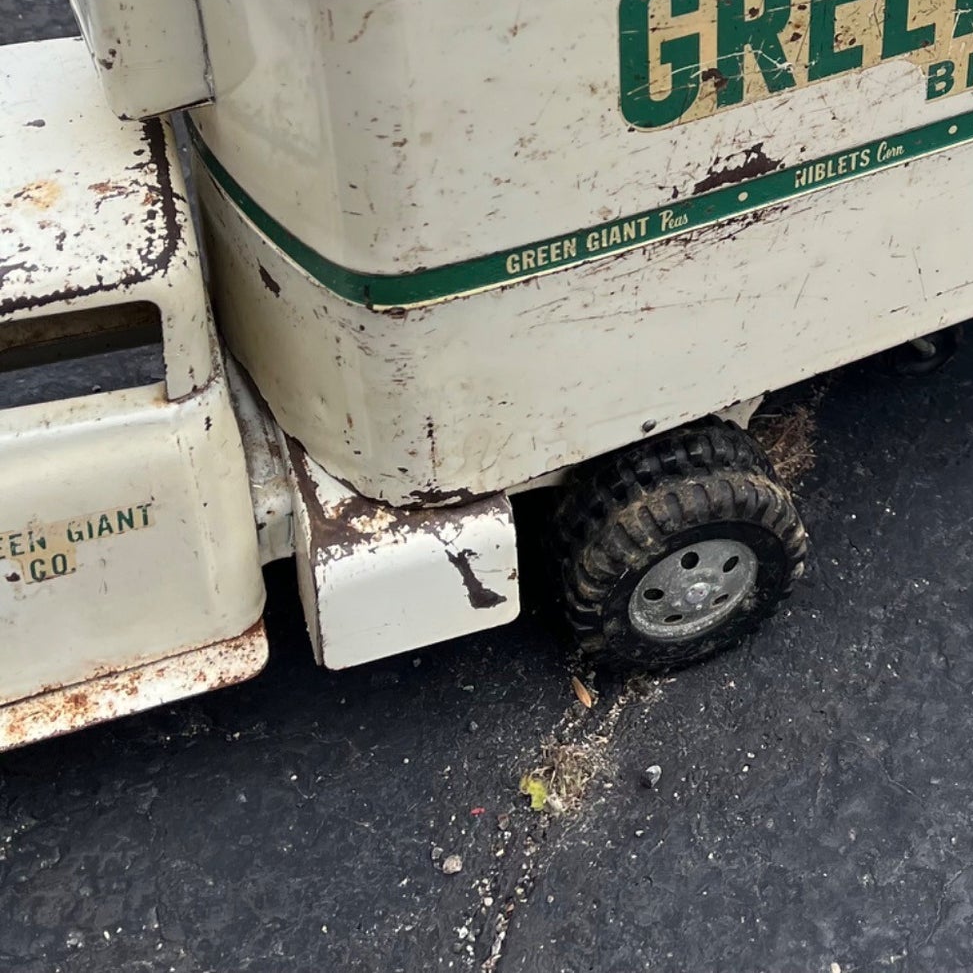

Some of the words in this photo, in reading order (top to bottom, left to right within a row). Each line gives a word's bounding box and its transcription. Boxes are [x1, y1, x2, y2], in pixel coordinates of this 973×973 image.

[794, 148, 871, 189] NIBLETS
[876, 141, 905, 163] Corn
[506, 238, 577, 275] GREEN
[586, 217, 650, 252] GIANT
[659, 209, 689, 232] Peas
[67, 503, 153, 543] GIANT
[29, 553, 77, 582] CO.
